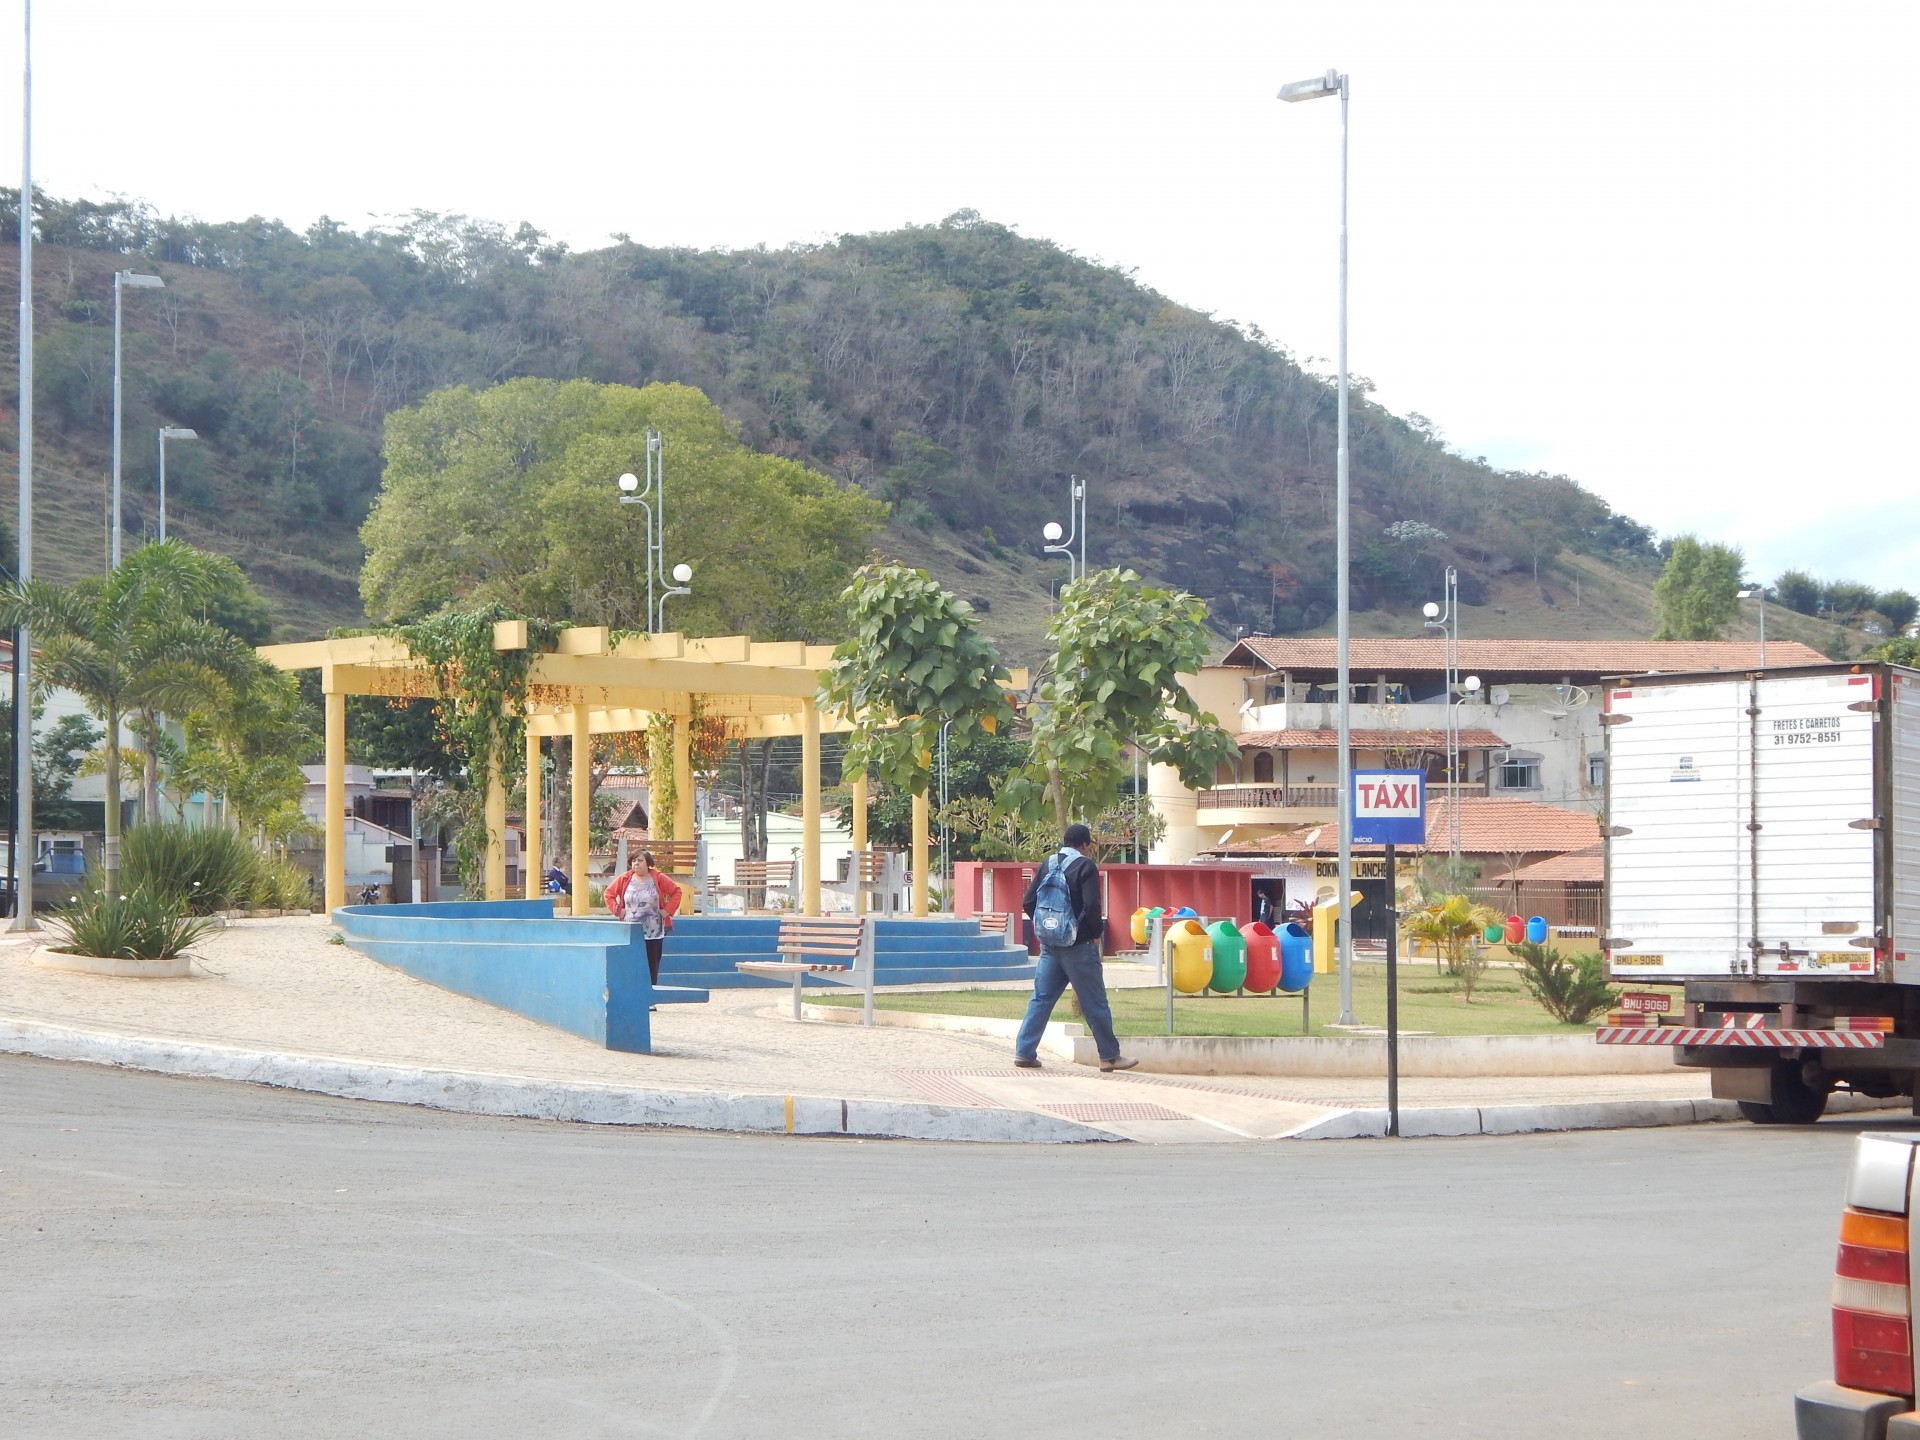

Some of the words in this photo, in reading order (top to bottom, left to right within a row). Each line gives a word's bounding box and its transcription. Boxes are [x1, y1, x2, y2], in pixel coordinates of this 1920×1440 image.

[1773, 720, 1798, 730] FRETES
[1799, 719, 1804, 729] E
[1805, 717, 1841, 729] CARRETOS
[1774, 735, 1785, 745] 31
[1787, 732, 1841, 745] 9752-8551
[1358, 779, 1418, 809] TÁXI
[1316, 862, 1339, 878] BOKIN
[1356, 862, 1387, 878] LANCHE
